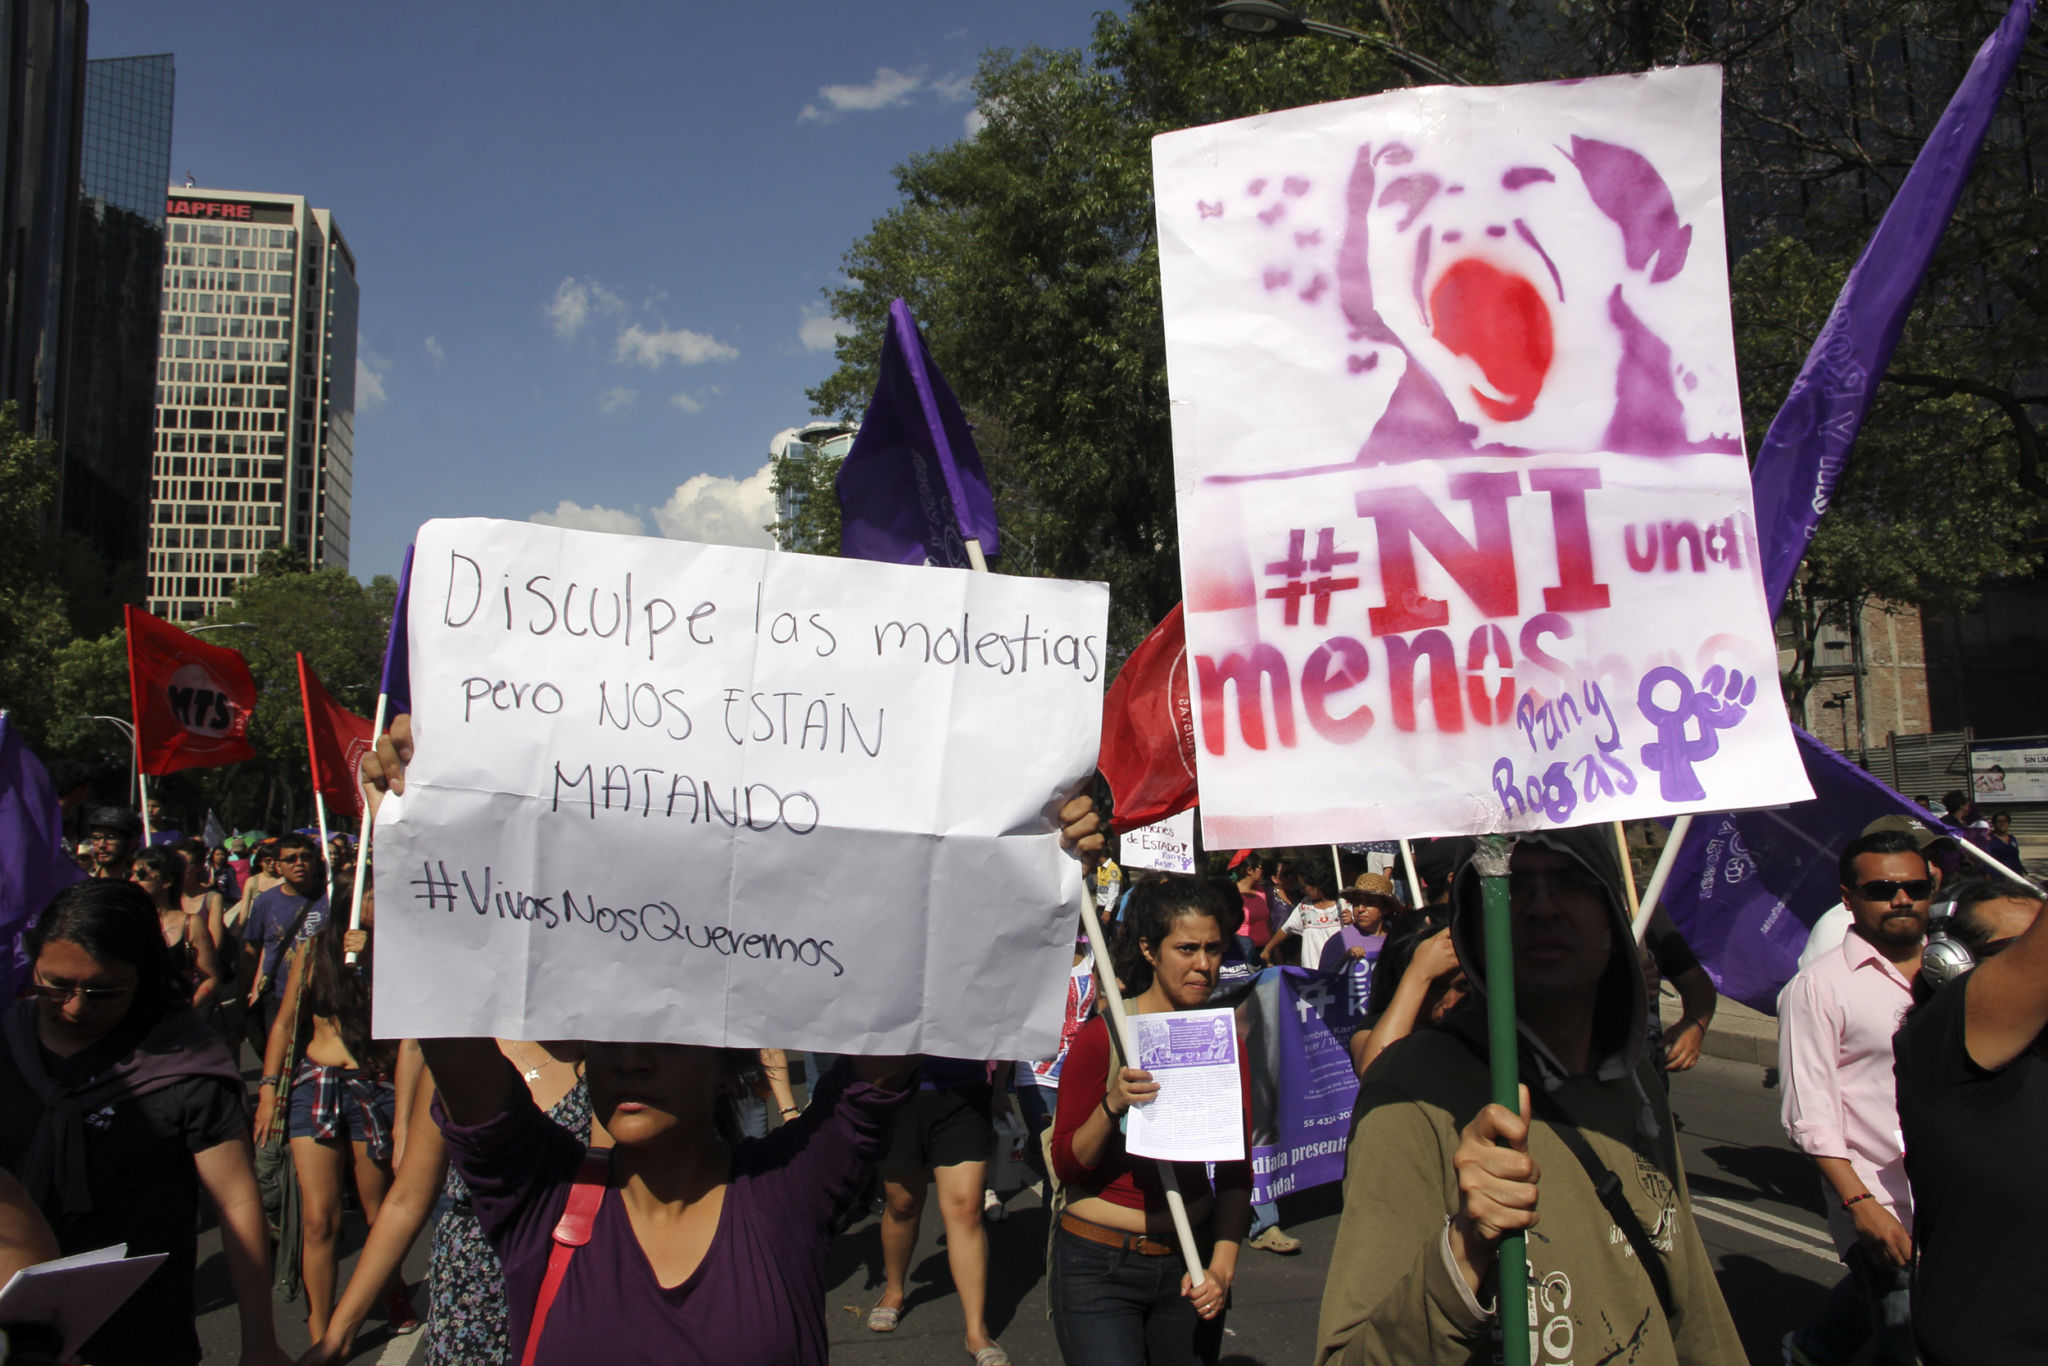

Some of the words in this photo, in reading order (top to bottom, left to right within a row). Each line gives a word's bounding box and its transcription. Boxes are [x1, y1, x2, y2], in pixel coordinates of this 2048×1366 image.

[1264, 467, 1611, 636] #NI
[1624, 513, 1746, 574] una
[444, 549, 717, 661] Disculpe
[755, 581, 837, 657] las
[875, 613, 1100, 683] molestias
[168, 684, 232, 731] MTS
[462, 677, 564, 723] pero
[599, 680, 693, 741] NOS
[723, 688, 884, 758] ESTÁN
[1194, 611, 1576, 757] menos
[553, 760, 820, 835] MATANDO
[410, 860, 845, 977] #VivasNosQueremos
[1303, 1118, 1315, 1128] 55
[1266, 1173, 1296, 1200] vida!
